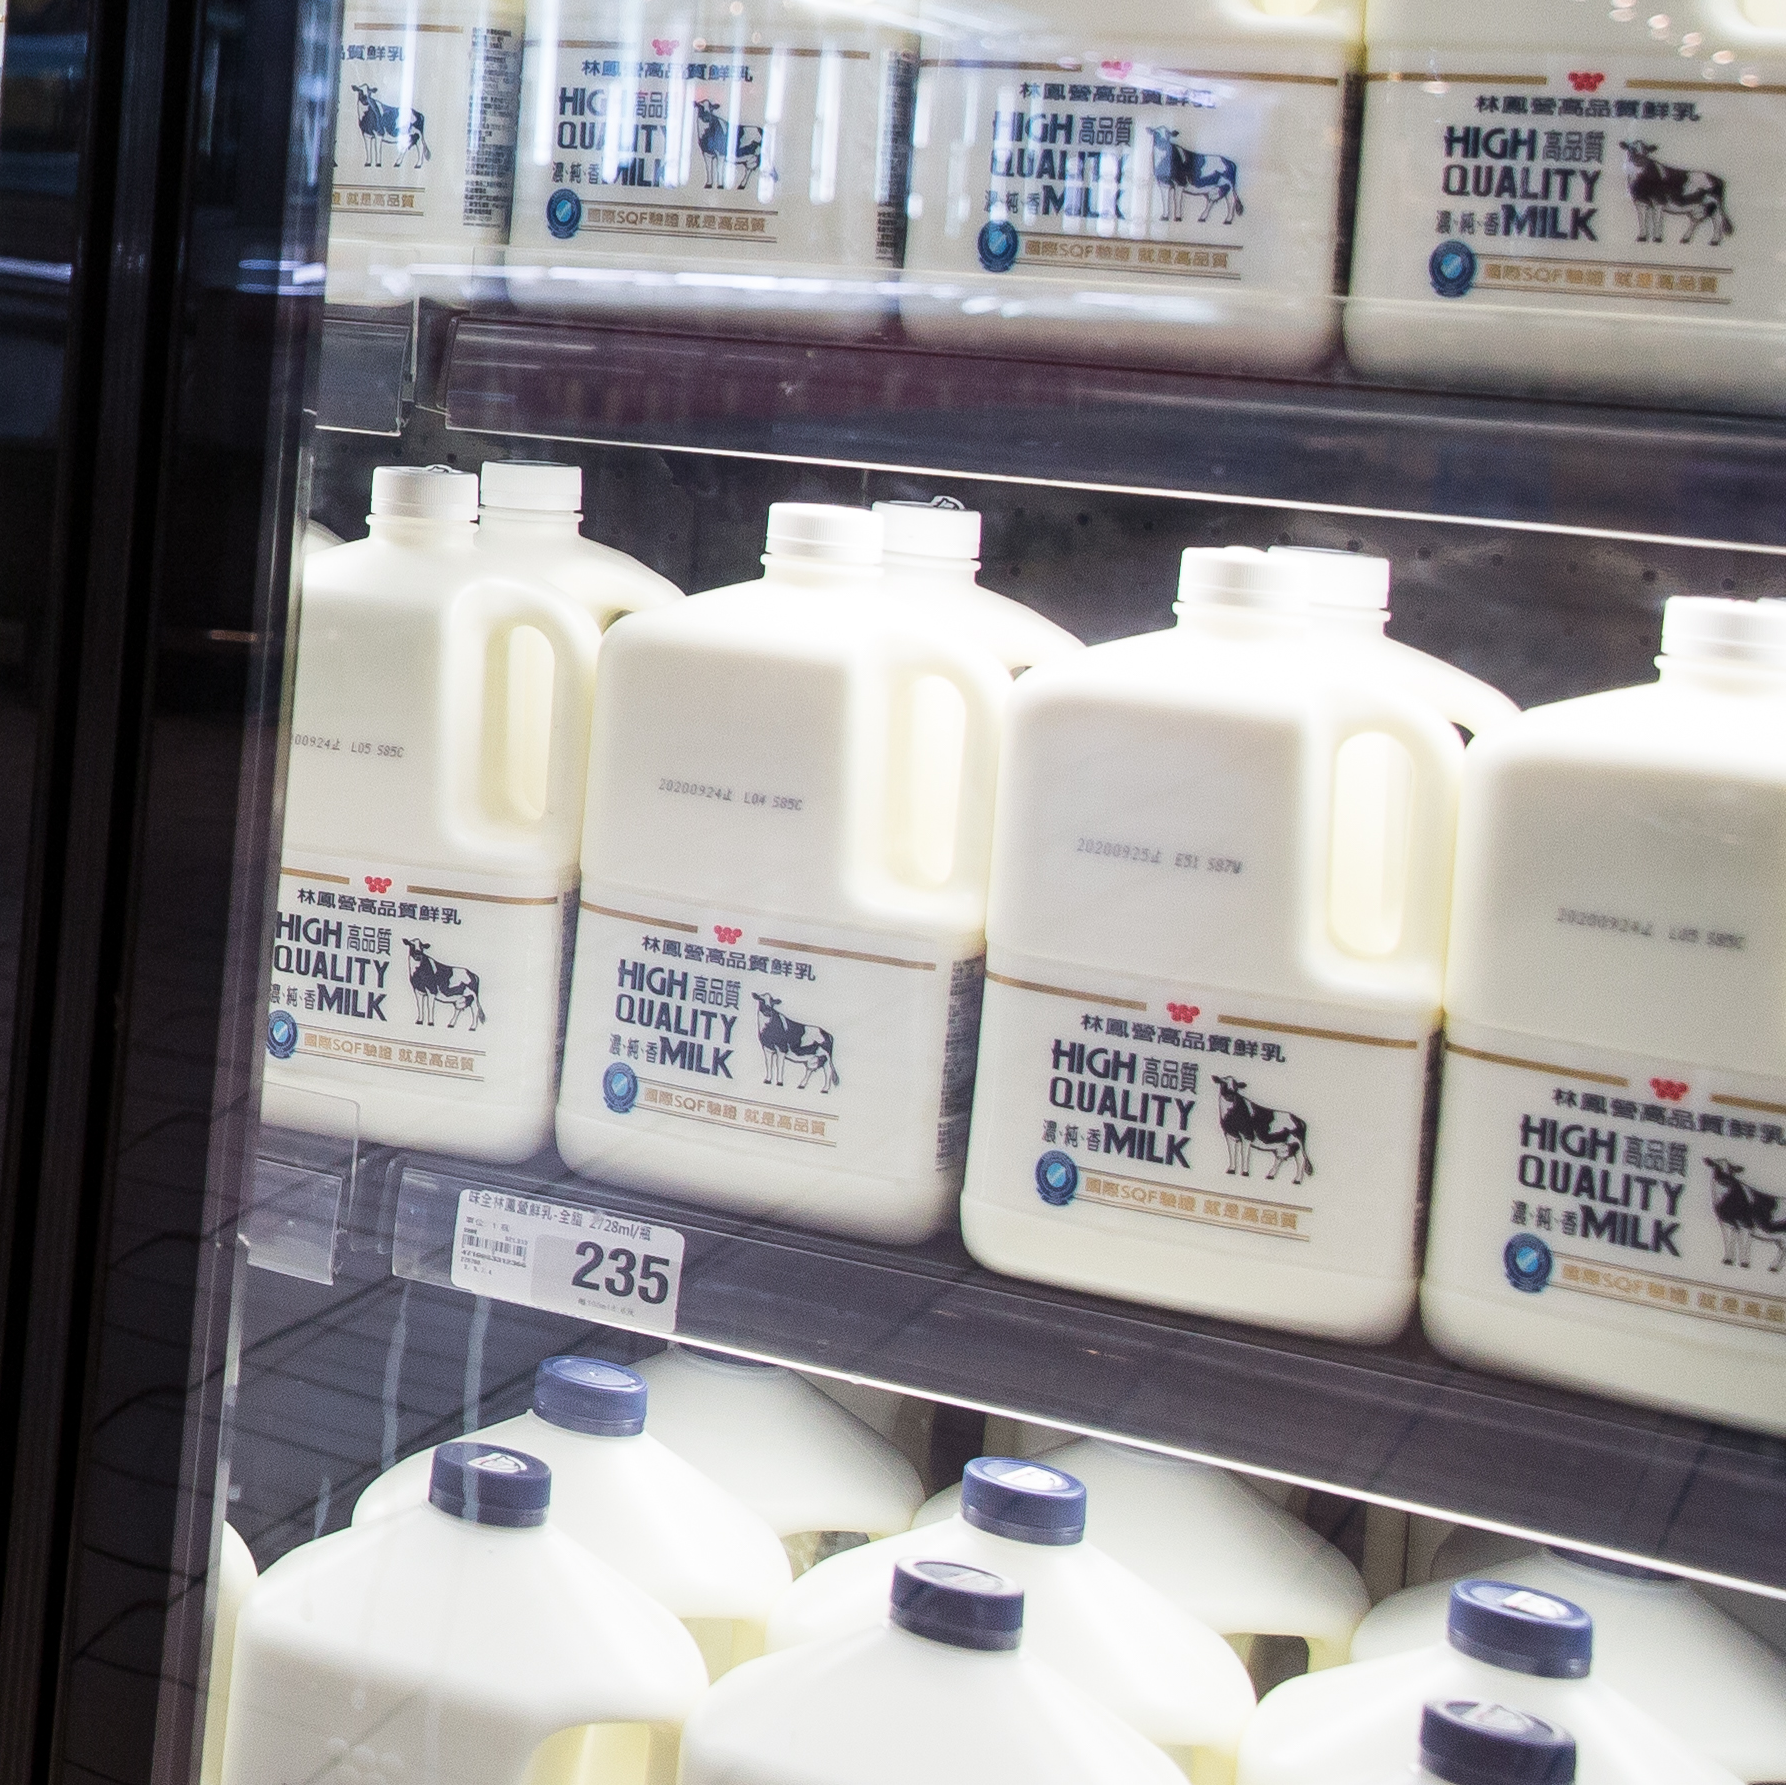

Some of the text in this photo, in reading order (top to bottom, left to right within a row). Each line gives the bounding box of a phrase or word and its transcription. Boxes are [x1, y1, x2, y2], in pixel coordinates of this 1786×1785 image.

[1476, 96, 1700, 121] 林鳳營高品質鮮乳
[1445, 126, 1605, 164] HIGH 高品質
[1443, 167, 1601, 203] QUALITY
[1501, 204, 1598, 241] MILK
[641, 935, 817, 981] 林鳳營高品質鮮乳
[618, 959, 741, 1010] HIGH 高品質
[615, 993, 737, 1043] QUALITY
[1081, 1014, 1286, 1063] 林鳳營高品質鮮乳
[659, 1036, 733, 1079] MILK
[1053, 1039, 1199, 1094] HIGH 高品質
[743, 1106, 827, 1136] 就是高品質
[1049, 1077, 1195, 1131] QUALITY
[1103, 1124, 1191, 1168] MILK
[571, 1241, 670, 1304] 235
